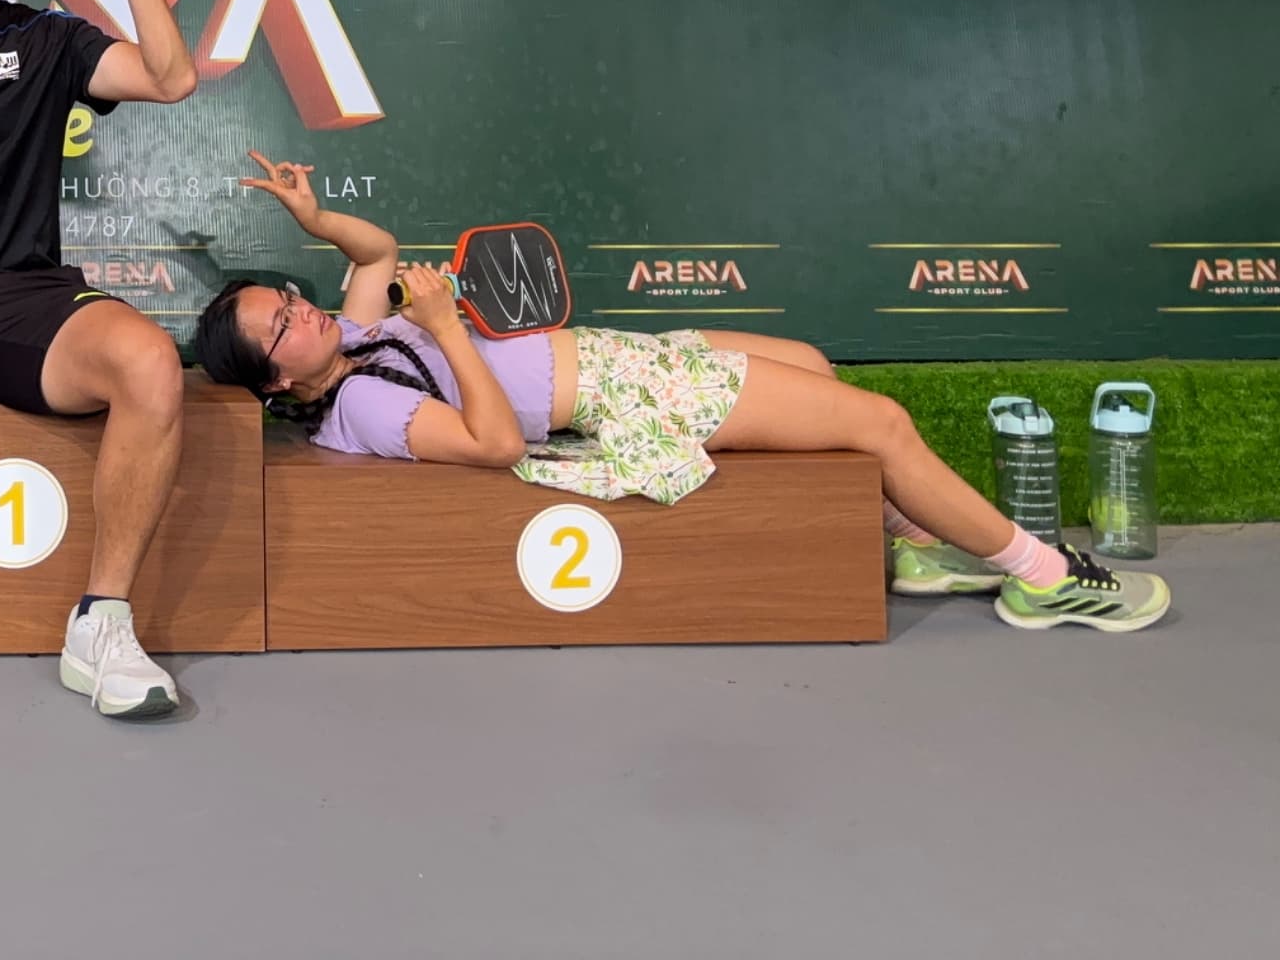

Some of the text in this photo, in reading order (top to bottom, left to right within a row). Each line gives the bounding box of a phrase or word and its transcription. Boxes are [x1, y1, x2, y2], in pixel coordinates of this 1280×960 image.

[61, 172, 170, 198] HƯỜNG
[326, 176, 377, 202] LẠT
[65, 216, 134, 237] 4787
[82, 261, 176, 293] RENA
[627, 260, 747, 292] ARENA
[909, 259, 1029, 291] ARENA
[1189, 259, 1280, 291] AREN
[549, 526, 591, 589] 2
